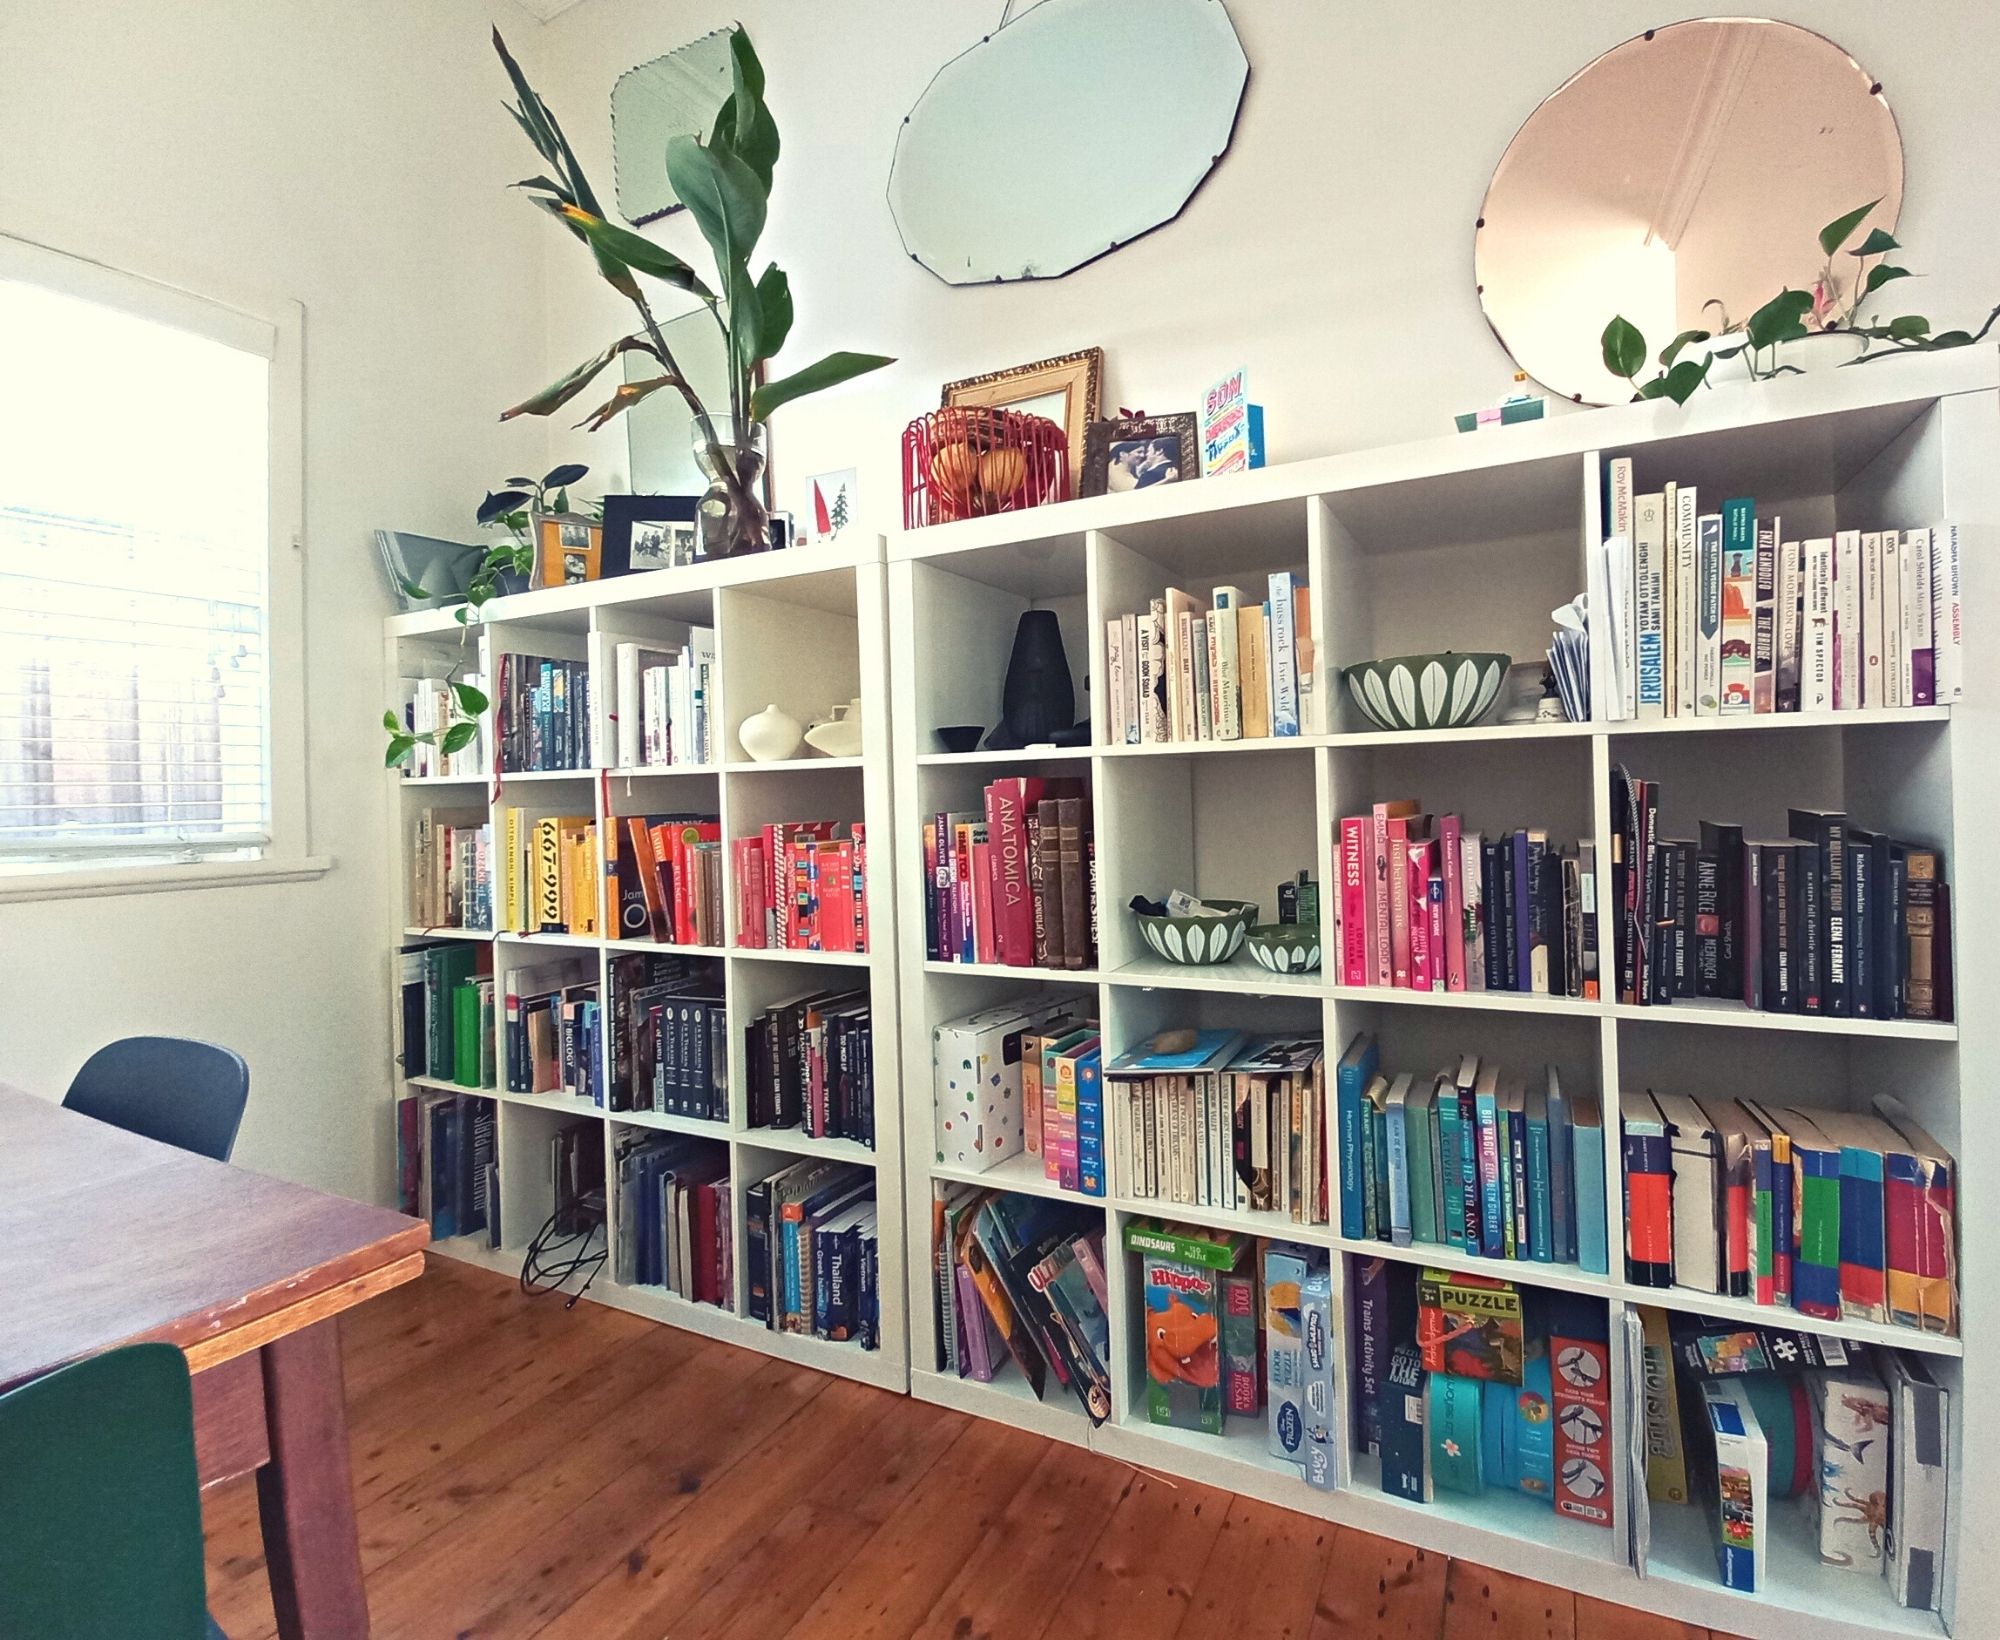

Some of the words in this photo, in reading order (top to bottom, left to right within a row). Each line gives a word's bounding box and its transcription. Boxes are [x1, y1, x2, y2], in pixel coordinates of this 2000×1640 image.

[1616, 466, 1627, 485] Roy
[1617, 488, 1627, 532] McMakin
[1682, 495, 1692, 569] COMMUNITY
[1759, 530, 1771, 550] ENZA
[1787, 548, 1796, 571] TONI
[1916, 539, 1924, 560] Carol
[1639, 542, 1648, 599] OTTOLENGHI
[1759, 553, 1771, 590] GANDOLFO
[1818, 551, 1828, 585] Identically
[1916, 562, 1925, 590] Shields
[1652, 572, 1660, 606] TAMIMI
[1785, 574, 1795, 623] MORRISON
[1820, 586, 1828, 613] different
[1276, 598, 1287, 625] bass
[1640, 602, 1649, 632] YOTAM
[1651, 608, 1660, 630] SAMI
[1758, 616, 1771, 632] THE
[1952, 602, 1960, 645] ASSEMBLY
[1277, 627, 1287, 652] rock
[1757, 634, 1771, 660] BRIDGE
[1784, 628, 1794, 650] LOVE
[1142, 660, 1150, 677] GOON
[1279, 662, 1289, 682] Evie
[1640, 634, 1661, 705] JERUSALEM
[1816, 649, 1824, 683] SPECTOR
[1142, 678, 1150, 698] SQUAD
[1222, 681, 1230, 723] Mauritius
[1280, 686, 1290, 712] Wyld
[1376, 813, 1386, 844] EMMA
[1647, 808, 1656, 843] Domestic
[1829, 827, 1841, 839] MY
[853, 856, 861, 871] Day
[999, 797, 1020, 906] ANATOMICA
[1346, 826, 1359, 886] WITNESS
[1391, 838, 1407, 861] Just
[1647, 844, 1655, 861] Bliss
[1830, 841, 1842, 880] BRILLIANT
[542, 822, 558, 919] 667-999
[959, 858, 968, 880] TOO
[1698, 861, 1716, 889] ANNE
[1856, 854, 1864, 881] Richard
[1393, 863, 1408, 910] between
[1807, 882, 1816, 901] stars
[1830, 884, 1842, 911] FRIEND
[1857, 883, 1865, 913] Dawkins
[1378, 892, 1388, 933] MENTAL
[1698, 891, 1717, 913] RICE
[1808, 904, 1816, 918] fall
[1034, 896, 1045, 938] Orlando
[1394, 913, 1403, 928] us
[1830, 917, 1843, 941] ELENA
[1676, 930, 1684, 947] ELENA
[1808, 920, 1817, 950] christie
[1379, 936, 1389, 964] LOAD
[1676, 949, 1684, 976] FERRANTE
[1704, 939, 1716, 979] MEMNOCH
[1779, 952, 1787, 966] ELENA
[1831, 944, 1843, 983] FERRANTE
[1779, 968, 1788, 991] FERRANTE
[1808, 953, 1816, 982] nieman
[1346, 1110, 1355, 1141] Human
[1481, 1110, 1490, 1124] BIG
[1482, 1127, 1494, 1156] MAGIC
[1345, 1143, 1355, 1192] Physiology
[1463, 1163, 1474, 1207] BIRCH
[1485, 1163, 1496, 1201] ELIZABETH
[1504, 1184, 1509, 1192] on
[1466, 1212, 1475, 1246] TONY
[1487, 1203, 1498, 1233] GILBERT
[1130, 1235, 1176, 1252] DINOSAURS
[1184, 1251, 1206, 1261] PUZZLE
[831, 1254, 844, 1306] Thailand
[1443, 1290, 1518, 1311] PUZZLE
[1362, 1299, 1376, 1331] Trains
[1362, 1332, 1376, 1376] Activity
[1392, 1355, 1406, 1363] GO
[1408, 1358, 1421, 1367] TO
[1284, 1351, 1292, 1386] PUZZLE
[1389, 1374, 1418, 1387] FUTURE
[1391, 1362, 1419, 1380] THE
[1233, 1373, 1244, 1410] JIGSAW
[1242, 1377, 1250, 1402] BOOK
[1365, 1378, 1376, 1394] Set
[1286, 1408, 1296, 1447] FROZEN
